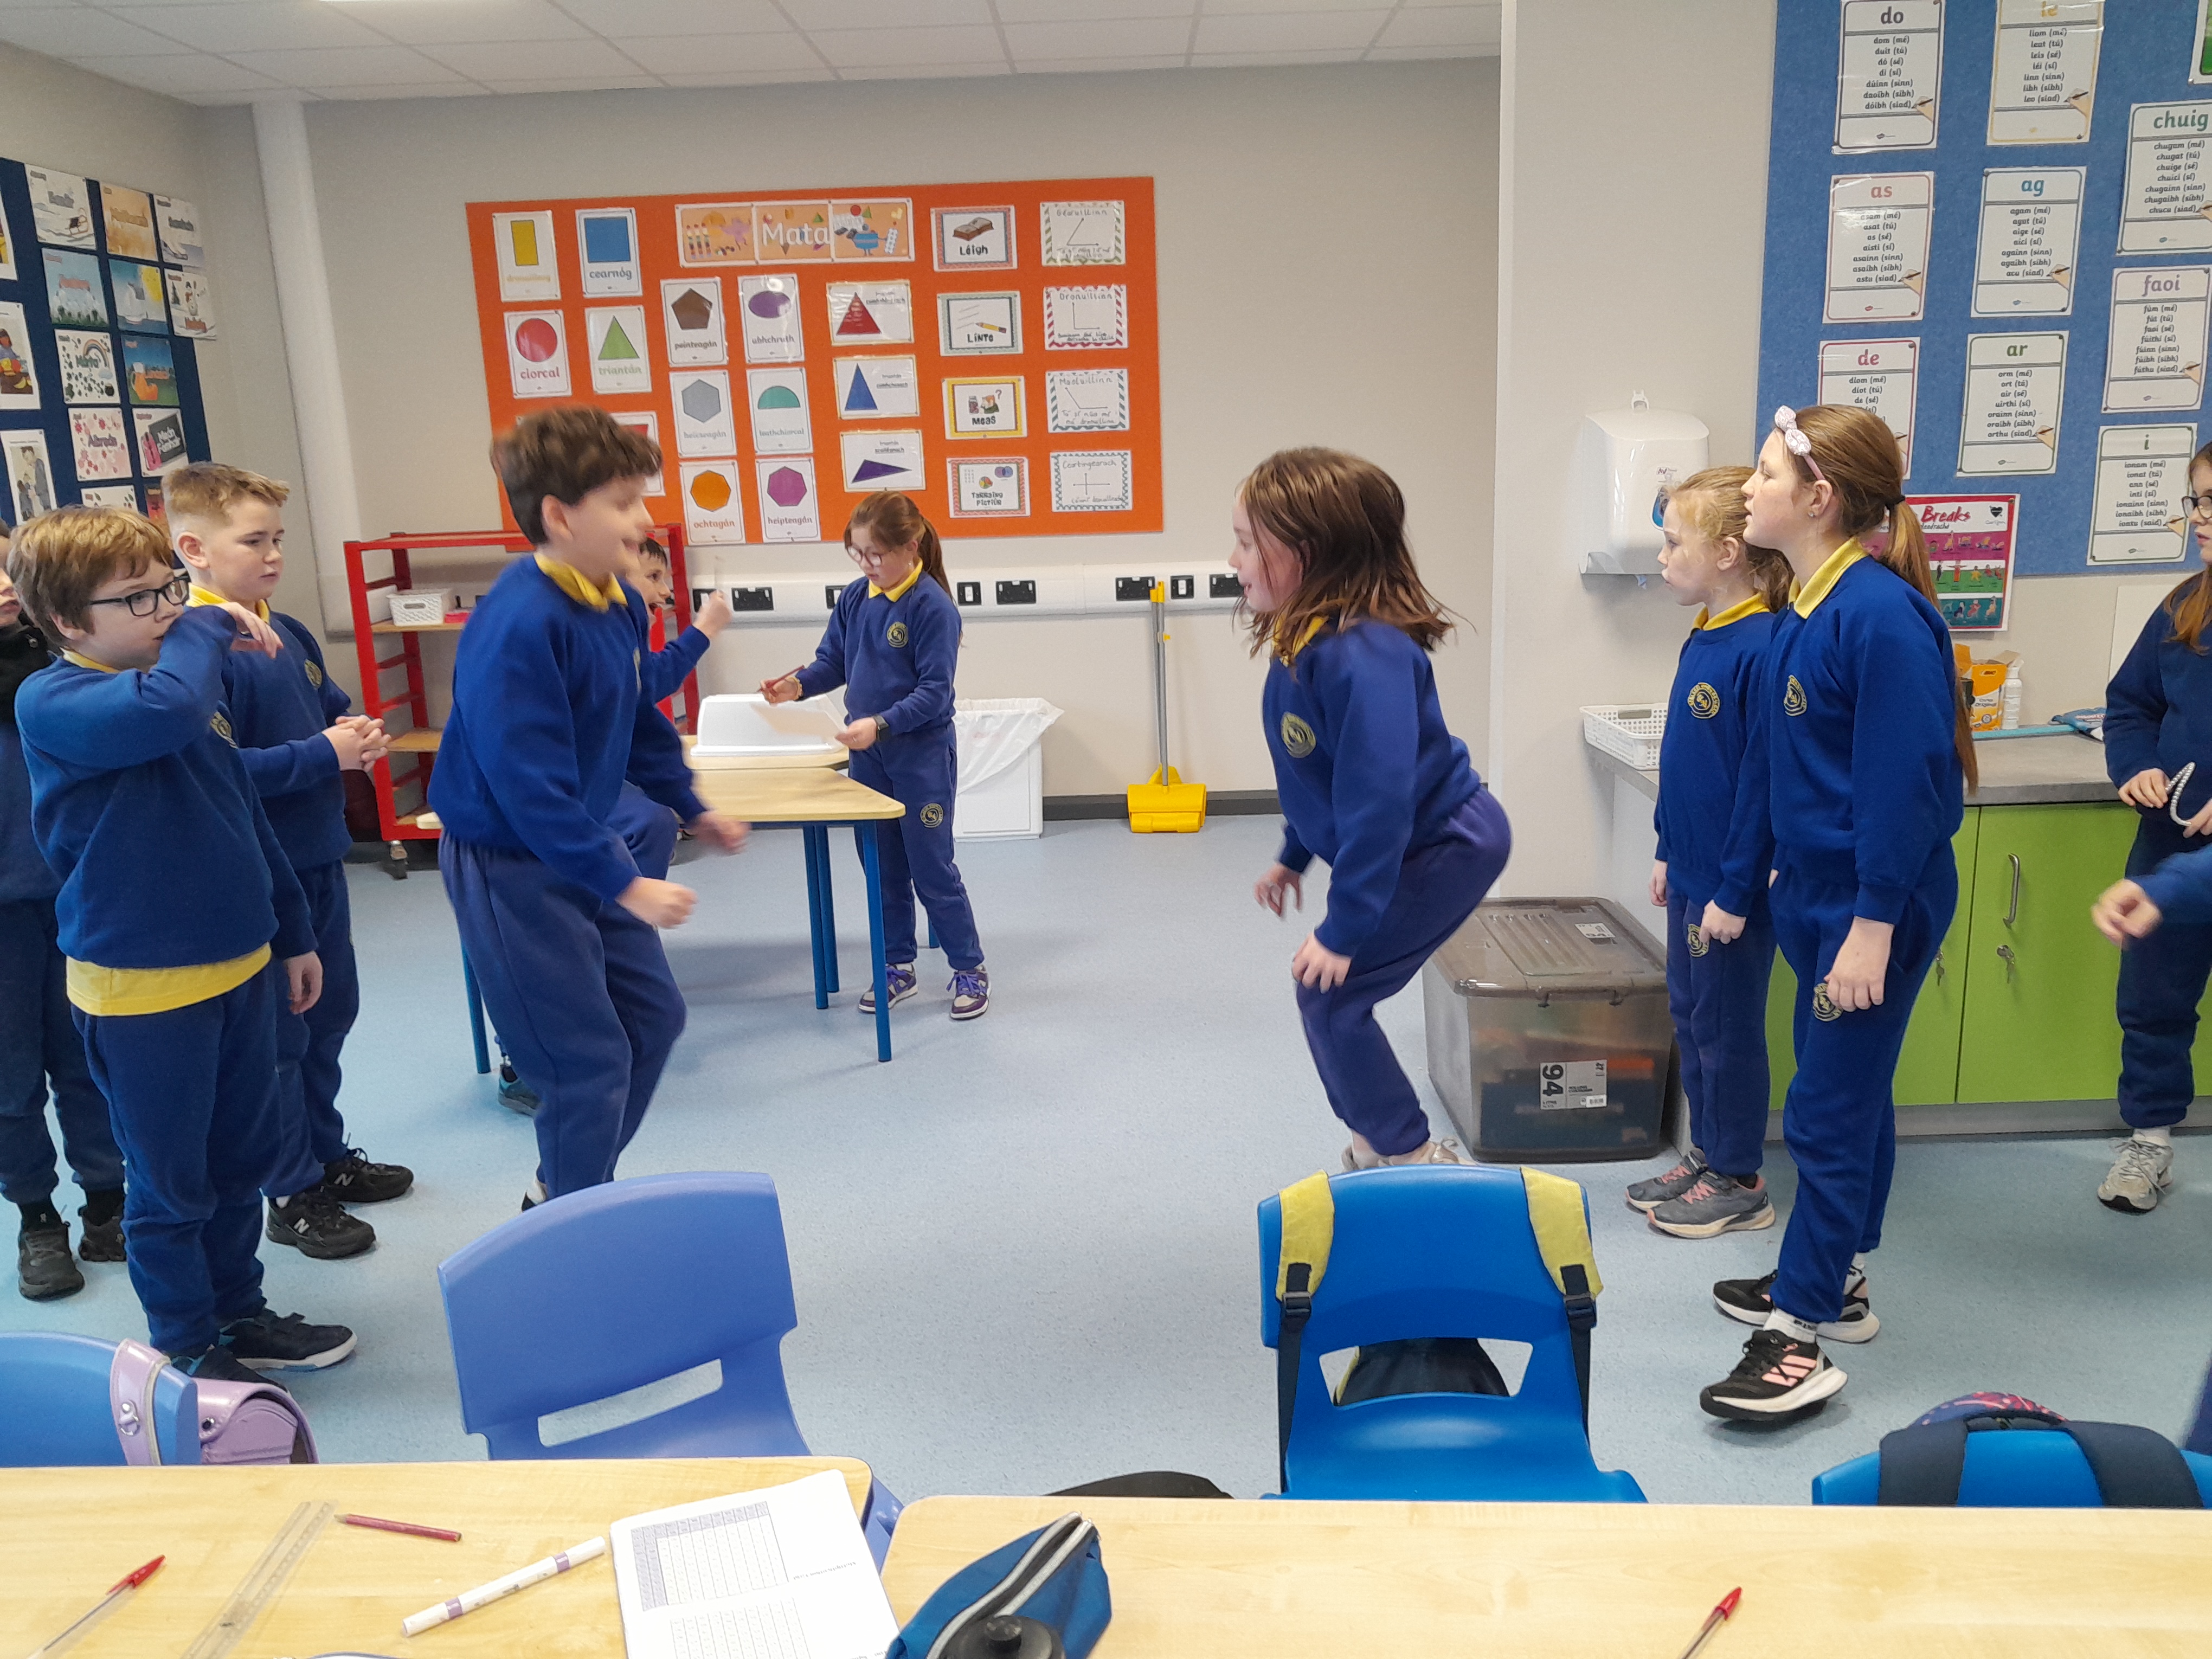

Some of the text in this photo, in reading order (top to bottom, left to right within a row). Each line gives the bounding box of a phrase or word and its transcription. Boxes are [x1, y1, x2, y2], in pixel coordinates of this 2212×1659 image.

[1881, 7, 1904, 24] do
[1893, 35, 1909, 44] (mé)
[2049, 39, 2063, 48] (tú)
[1894, 47, 1907, 55] (tú)
[2047, 50, 2061, 59] (sé)
[1890, 57, 1904, 66] (sé)
[2045, 62, 2057, 70] (sí)
[1889, 68, 1901, 77] (sí)
[2042, 72, 2065, 81] (sinn)
[1891, 79, 1913, 88] (sinn)
[2041, 83, 2063, 92] (sibh)
[1863, 89, 1914, 99] daoibh (sibh)
[2038, 94, 2060, 103] (siad)
[1889, 100, 1911, 110] (siad)
[2153, 110, 2208, 132] chuig
[2156, 153, 2183, 161] chugat
[2156, 164, 2182, 172] chuige
[2183, 173, 2195, 182] (sí)
[2022, 179, 2044, 196] ag
[2184, 183, 2205, 191] (sinn)
[1871, 186, 1892, 198] as
[2144, 194, 2204, 204] chugaibh (sibh)
[2174, 205, 2196, 214] (siad)
[1883, 222, 1896, 230] (tú)
[762, 222, 830, 247] Mata
[2031, 227, 2044, 235] (sé)
[1879, 233, 1892, 241] (sé)
[1883, 243, 1895, 252] (sí)
[1881, 253, 1903, 262] (sinn)
[2002, 248, 2052, 258] againn (sinn)
[1881, 263, 1902, 272] (sibh)
[2001, 259, 2051, 268] agaibh (sibh)
[589, 267, 632, 280] cearnóg
[1875, 275, 1896, 283] (siad)
[2142, 274, 2181, 297] faoi
[2160, 314, 2173, 323] (tú)
[2161, 324, 2174, 333] (sé)
[2164, 335, 2176, 343] (sí)
[2007, 345, 2028, 356] ar
[1858, 349, 1879, 365] de
[2158, 355, 2178, 363] (sibh)
[2016, 370, 2032, 378] (mé)
[2157, 365, 2178, 374] (siad)
[1870, 376, 1886, 384] (mé)
[1869, 386, 1882, 394] (tú)
[2019, 400, 2030, 408] (sí)
[2015, 410, 2036, 419] (sinn)
[2014, 420, 2035, 428] (sibh)
[2011, 429, 2033, 438] (siad)
[2144, 434, 2149, 450] i
[2145, 490, 2156, 498] (sí)
[2147, 500, 2168, 508] (sinn)
[1921, 505, 1971, 523] Breaks
[2146, 509, 2166, 518] (sibh)
[693, 519, 735, 529] ochtagán
[1541, 1064, 1564, 1097] 94
[334, 1173, 355, 1186] N
[293, 1218, 310, 1234] N
